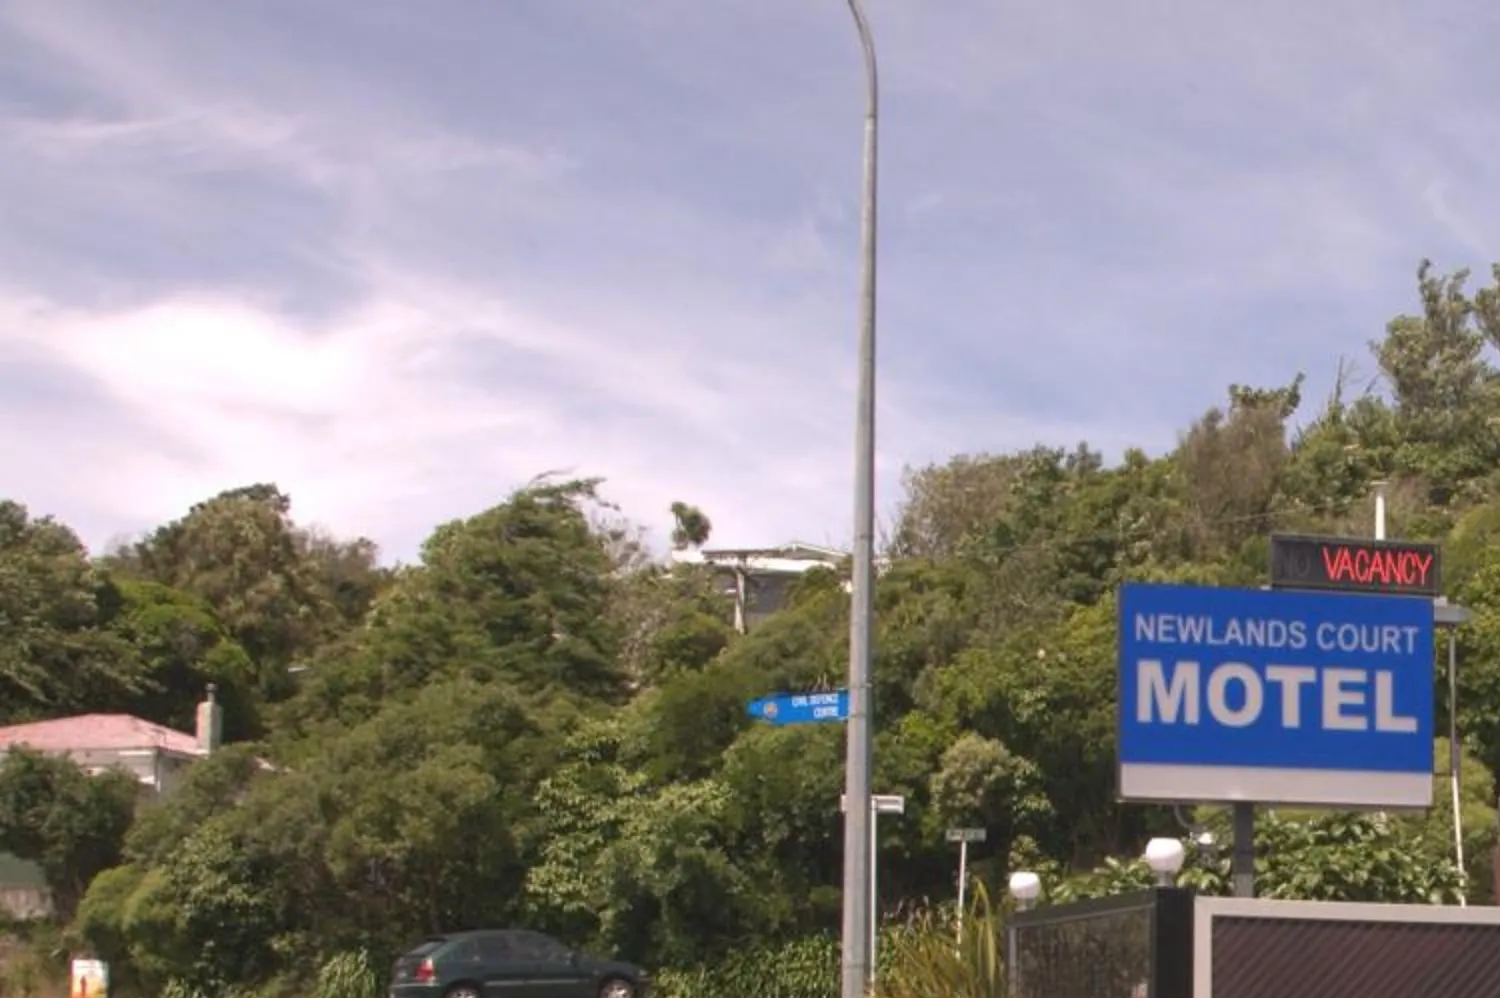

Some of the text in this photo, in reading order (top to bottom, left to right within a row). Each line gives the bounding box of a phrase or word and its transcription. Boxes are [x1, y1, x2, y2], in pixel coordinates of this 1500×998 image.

[1322, 545, 1433, 586] VACANCY
[1134, 612, 1419, 655] NEWLANDS COURT
[1136, 659, 1418, 734] MOTEL
